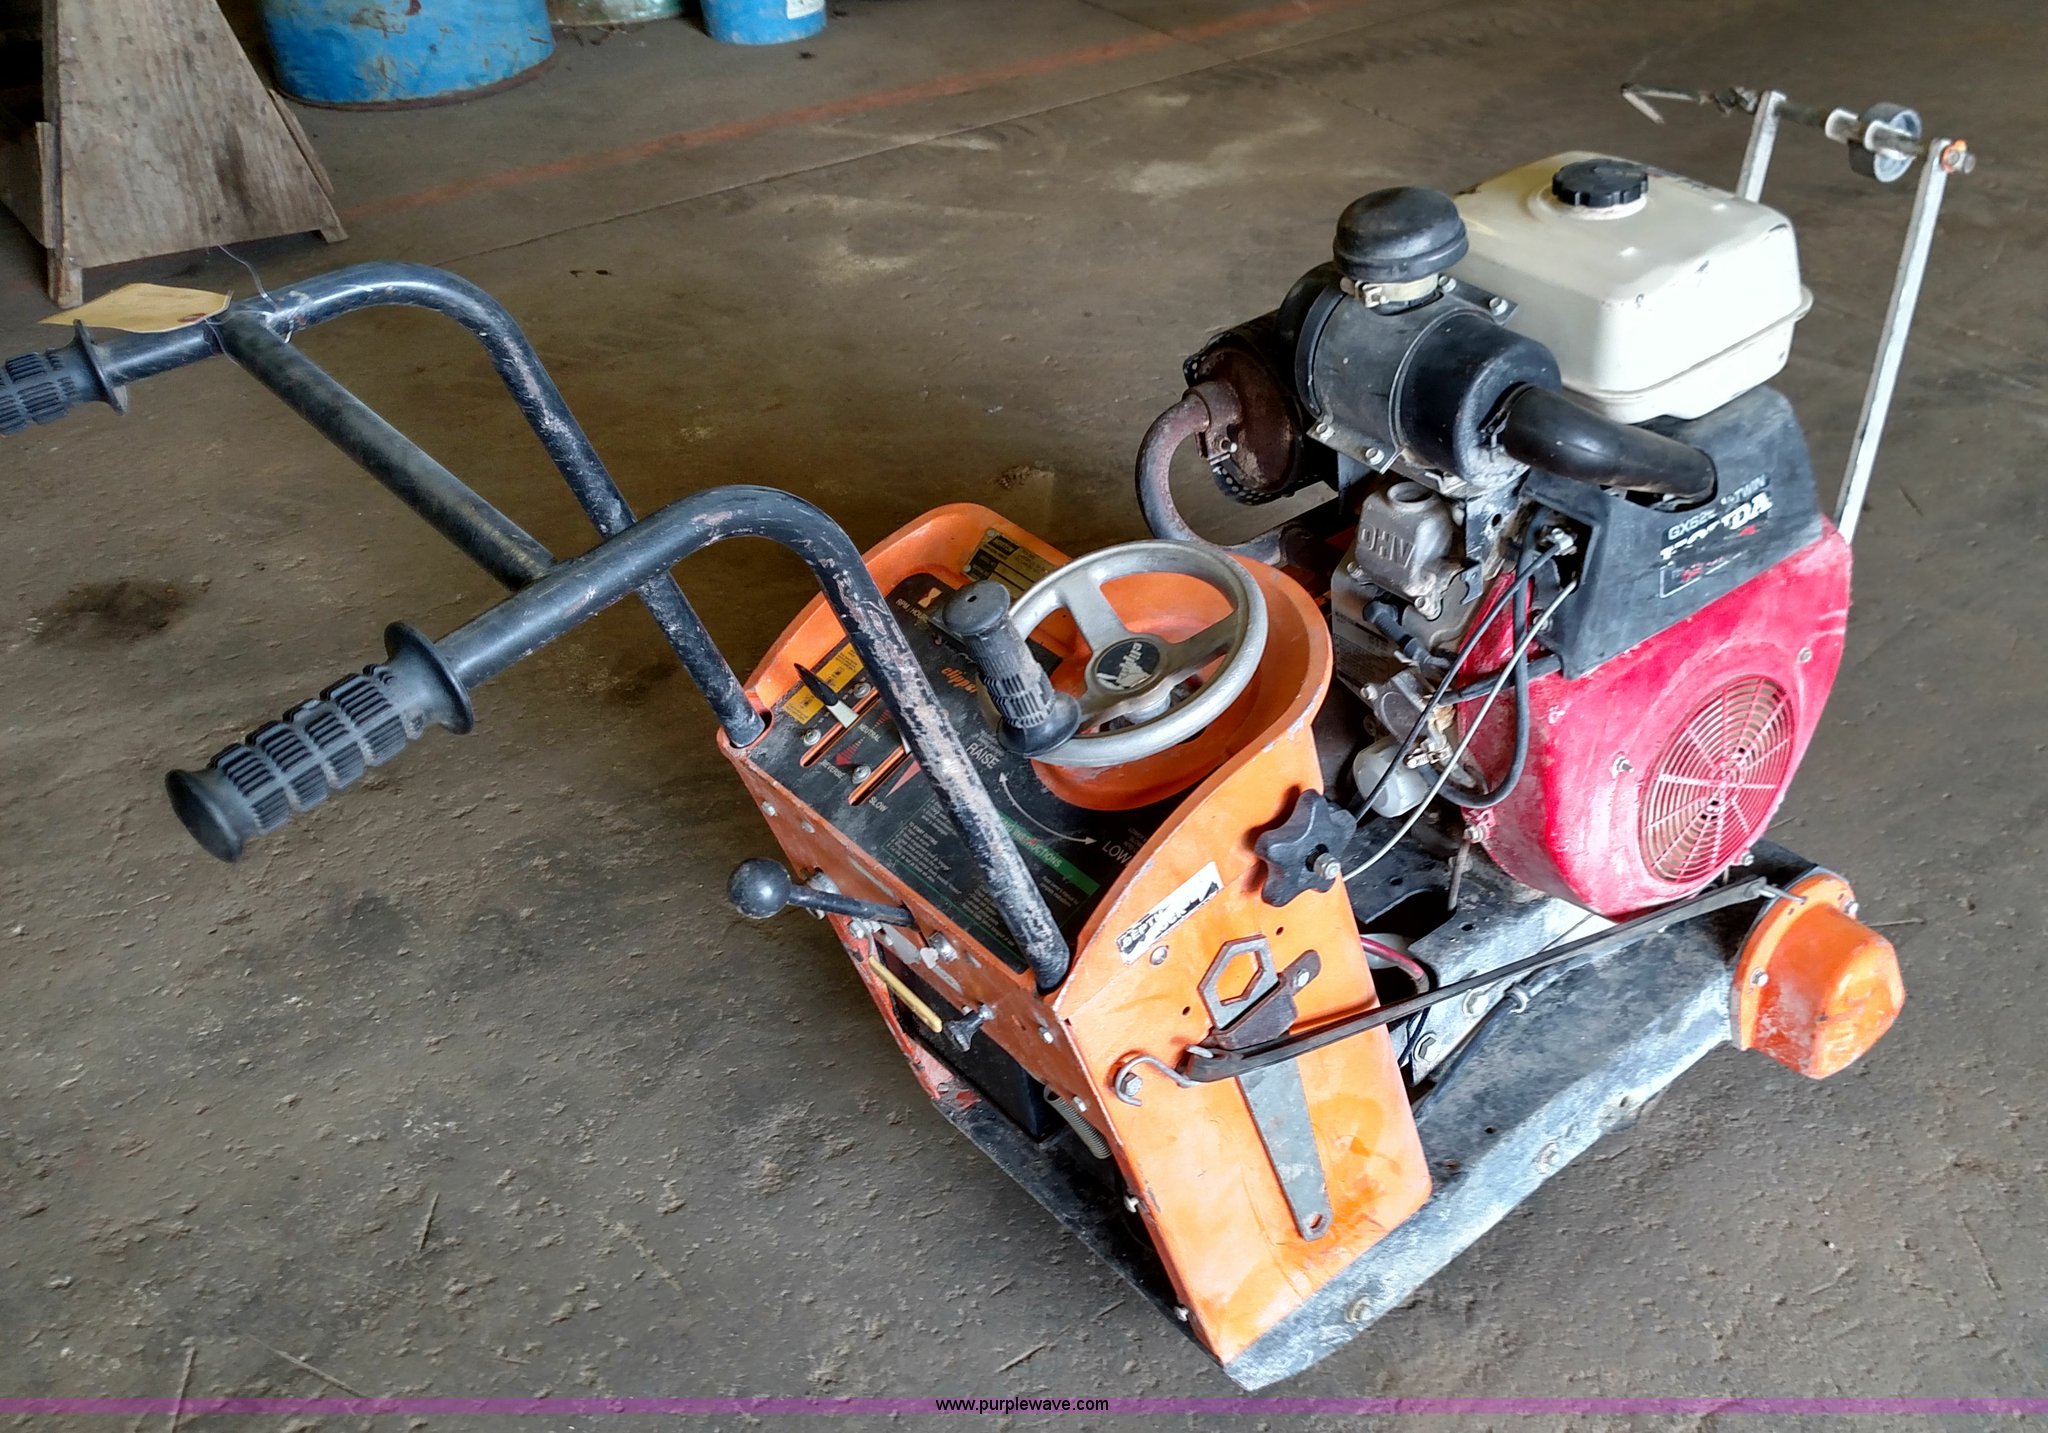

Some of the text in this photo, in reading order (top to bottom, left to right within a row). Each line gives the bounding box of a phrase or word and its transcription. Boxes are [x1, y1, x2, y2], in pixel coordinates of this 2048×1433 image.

[1360, 527, 1417, 570] OHV
[857, 722, 882, 743] NEUTRAL
[965, 743, 1000, 769] RAISE
[819, 759, 847, 780] REVERSE
[868, 796, 889, 812] SLOW
[1101, 841, 1132, 864] LOW
